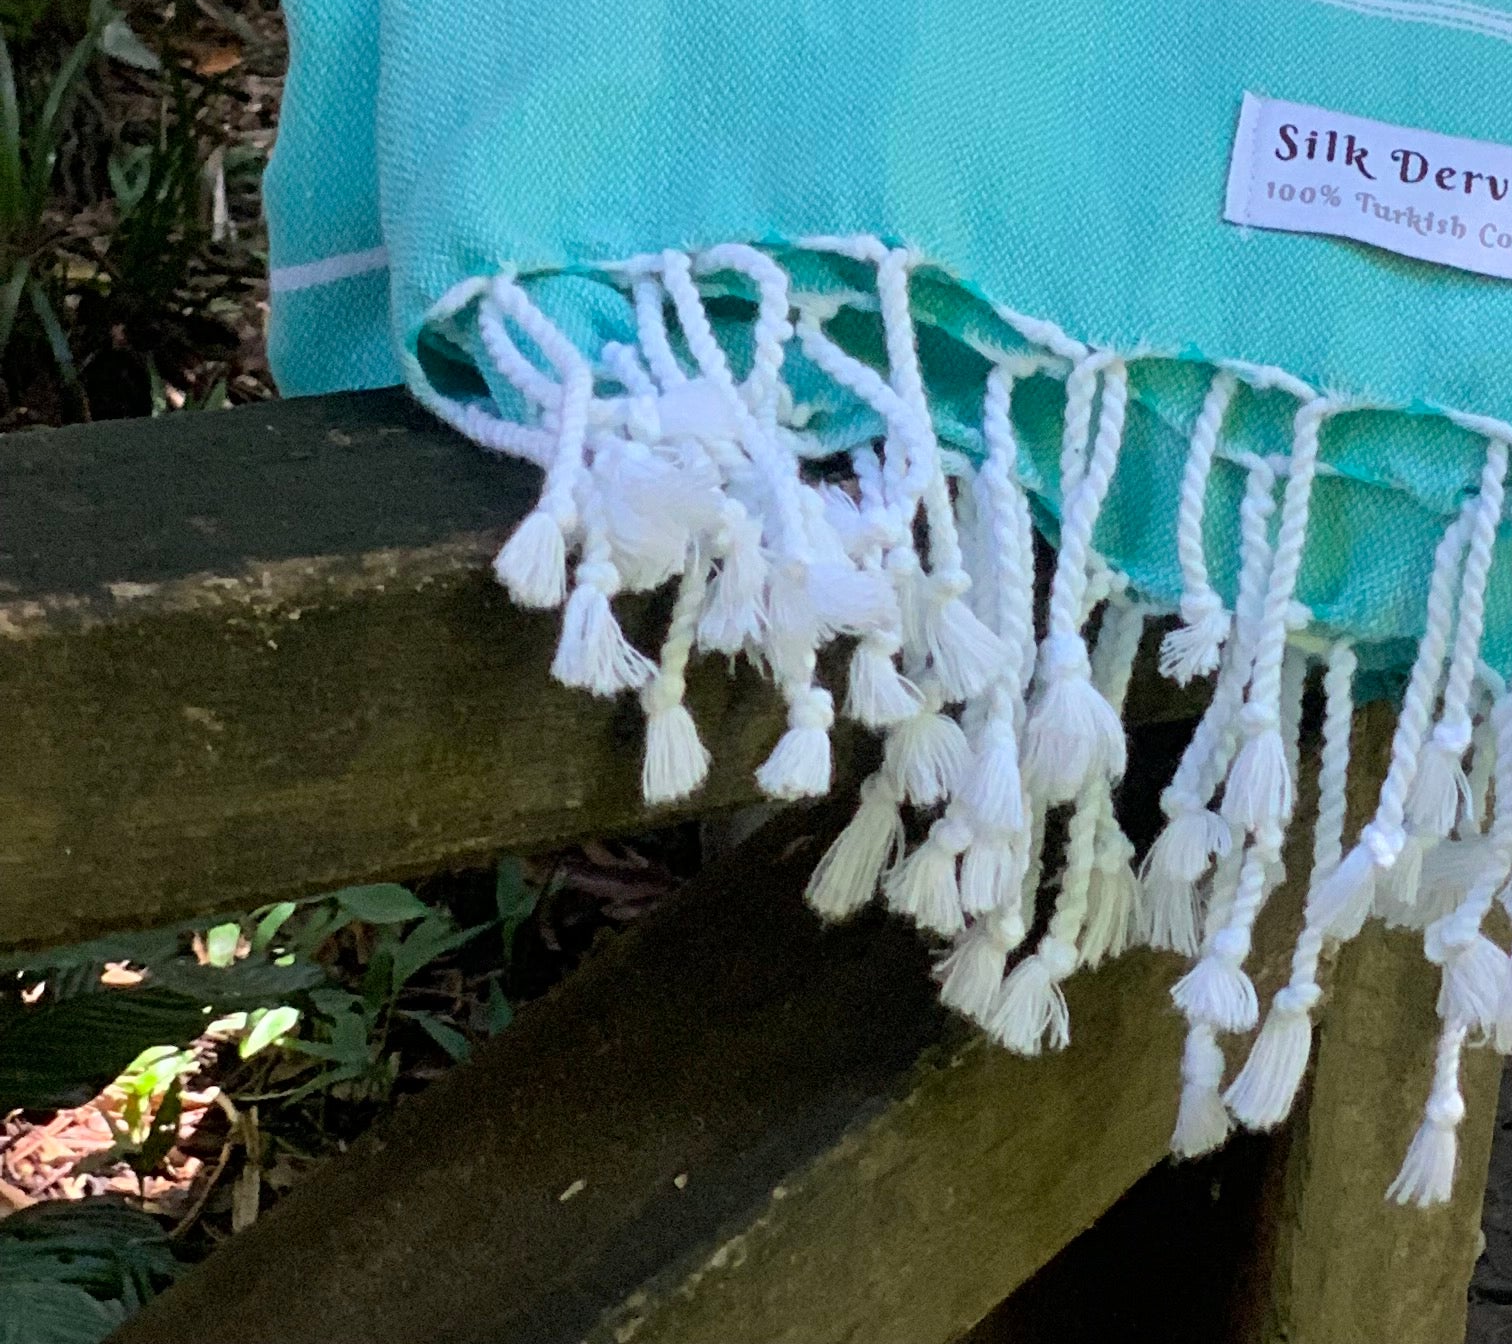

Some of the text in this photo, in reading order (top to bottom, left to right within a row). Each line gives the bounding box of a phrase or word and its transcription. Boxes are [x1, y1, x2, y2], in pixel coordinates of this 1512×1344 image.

[1274, 123, 1377, 180] Silk
[1266, 181, 1342, 208] 100%
[1354, 191, 1467, 240] Turkish
